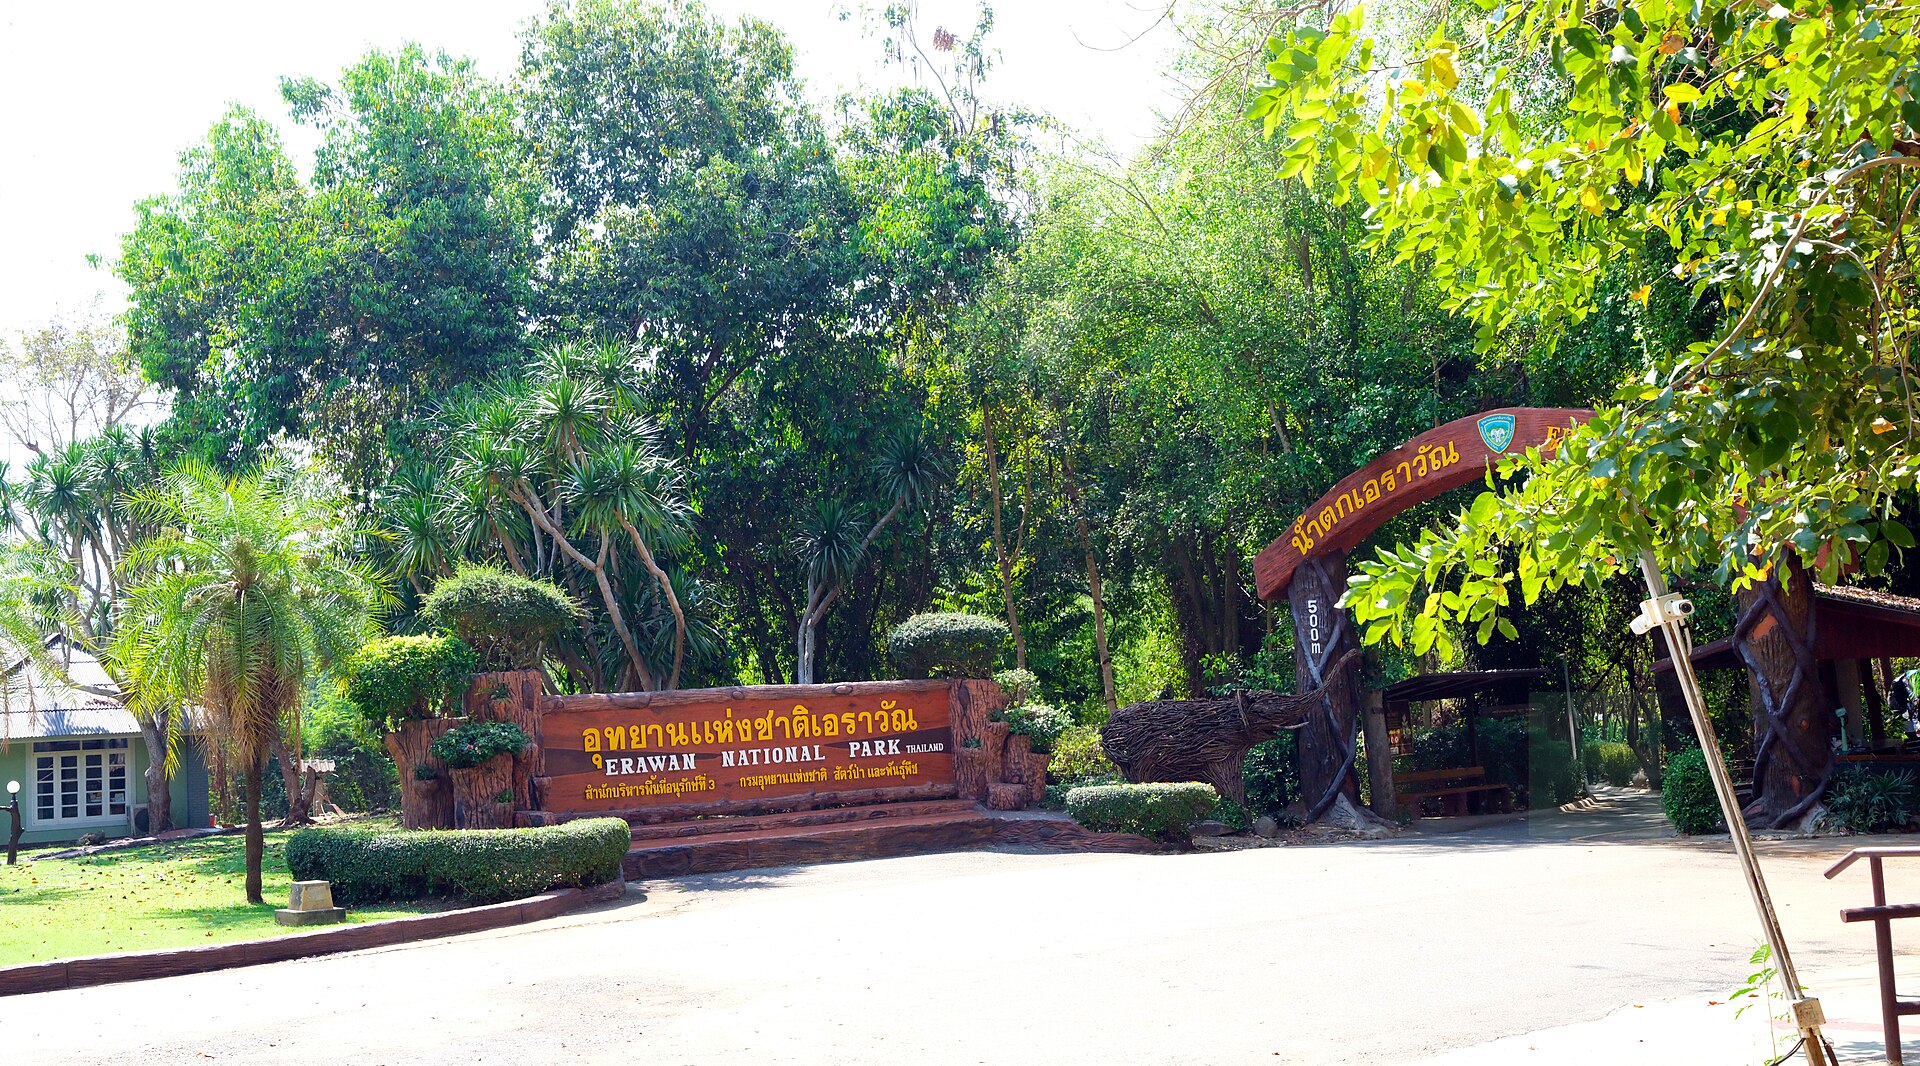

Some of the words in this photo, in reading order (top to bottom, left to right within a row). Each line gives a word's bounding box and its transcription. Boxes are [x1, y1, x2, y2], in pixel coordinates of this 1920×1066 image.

[1291, 441, 1460, 555] น้ำตกเอราวัณ
[582, 700, 918, 769] อุทยานแห่งชาติเอราวัณ
[605, 753, 696, 776] ERAWAN
[721, 745, 826, 768] NATIONAL
[849, 739, 901, 758] PARK
[906, 743, 944, 754] THAILAND
[709, 780, 716, 791] 3
